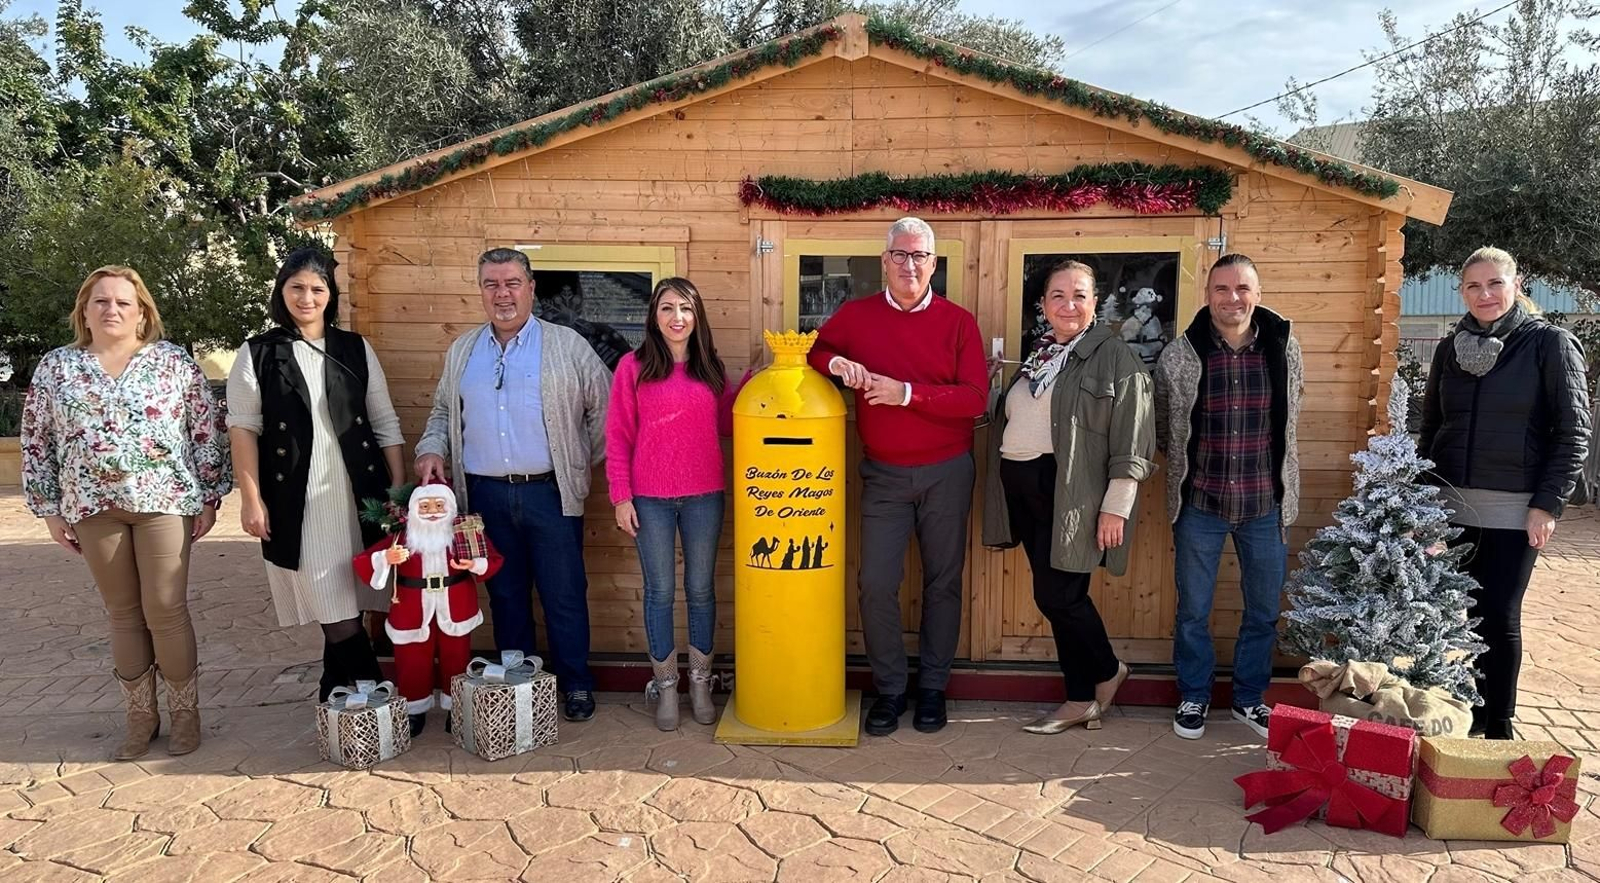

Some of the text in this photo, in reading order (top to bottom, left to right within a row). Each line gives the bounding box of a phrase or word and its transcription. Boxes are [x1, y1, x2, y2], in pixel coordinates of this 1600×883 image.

[745, 466, 834, 480] Buzón De Los
[747, 486, 833, 500] Reyes Magos
[755, 505, 825, 518] De Oriente
[1431, 716, 1453, 736] DO
